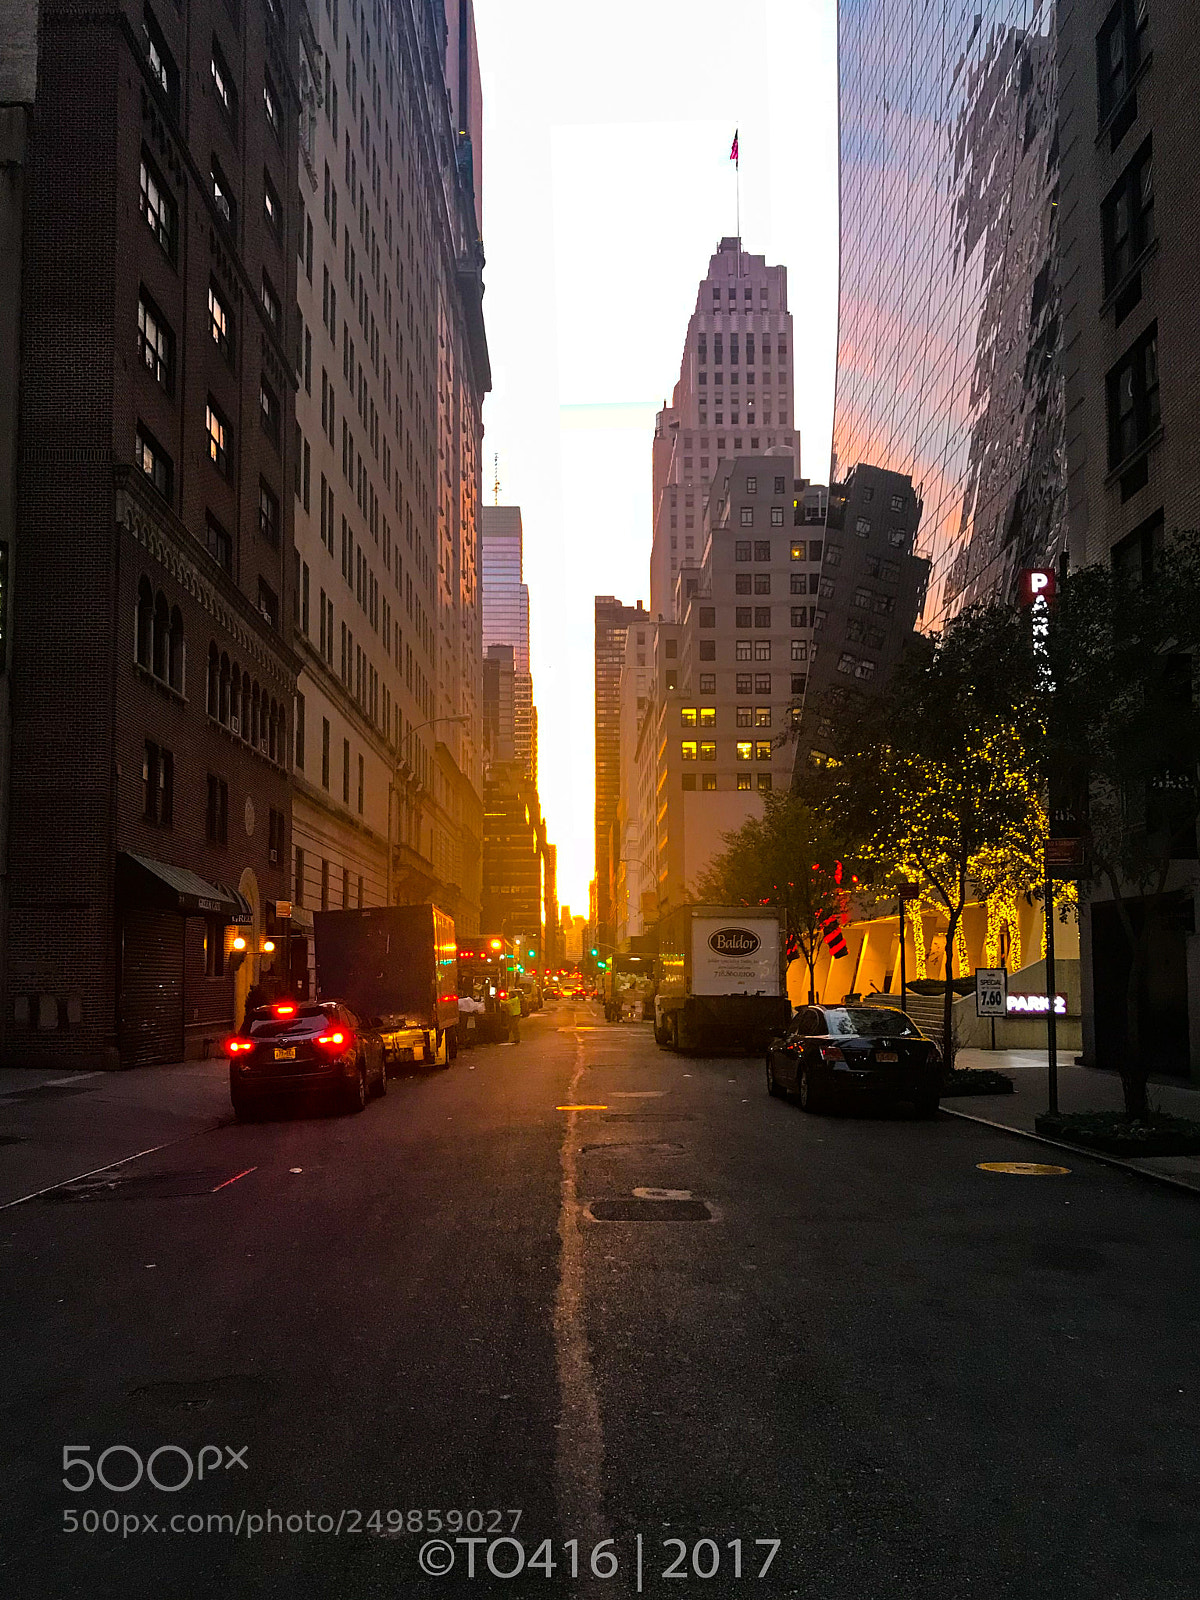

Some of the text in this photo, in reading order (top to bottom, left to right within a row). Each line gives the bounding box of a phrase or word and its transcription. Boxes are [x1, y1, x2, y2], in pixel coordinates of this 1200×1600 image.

[716, 934, 756, 949] Baldor
[981, 991, 1002, 1006] 7.60
[1006, 995, 1051, 1012] PARK
